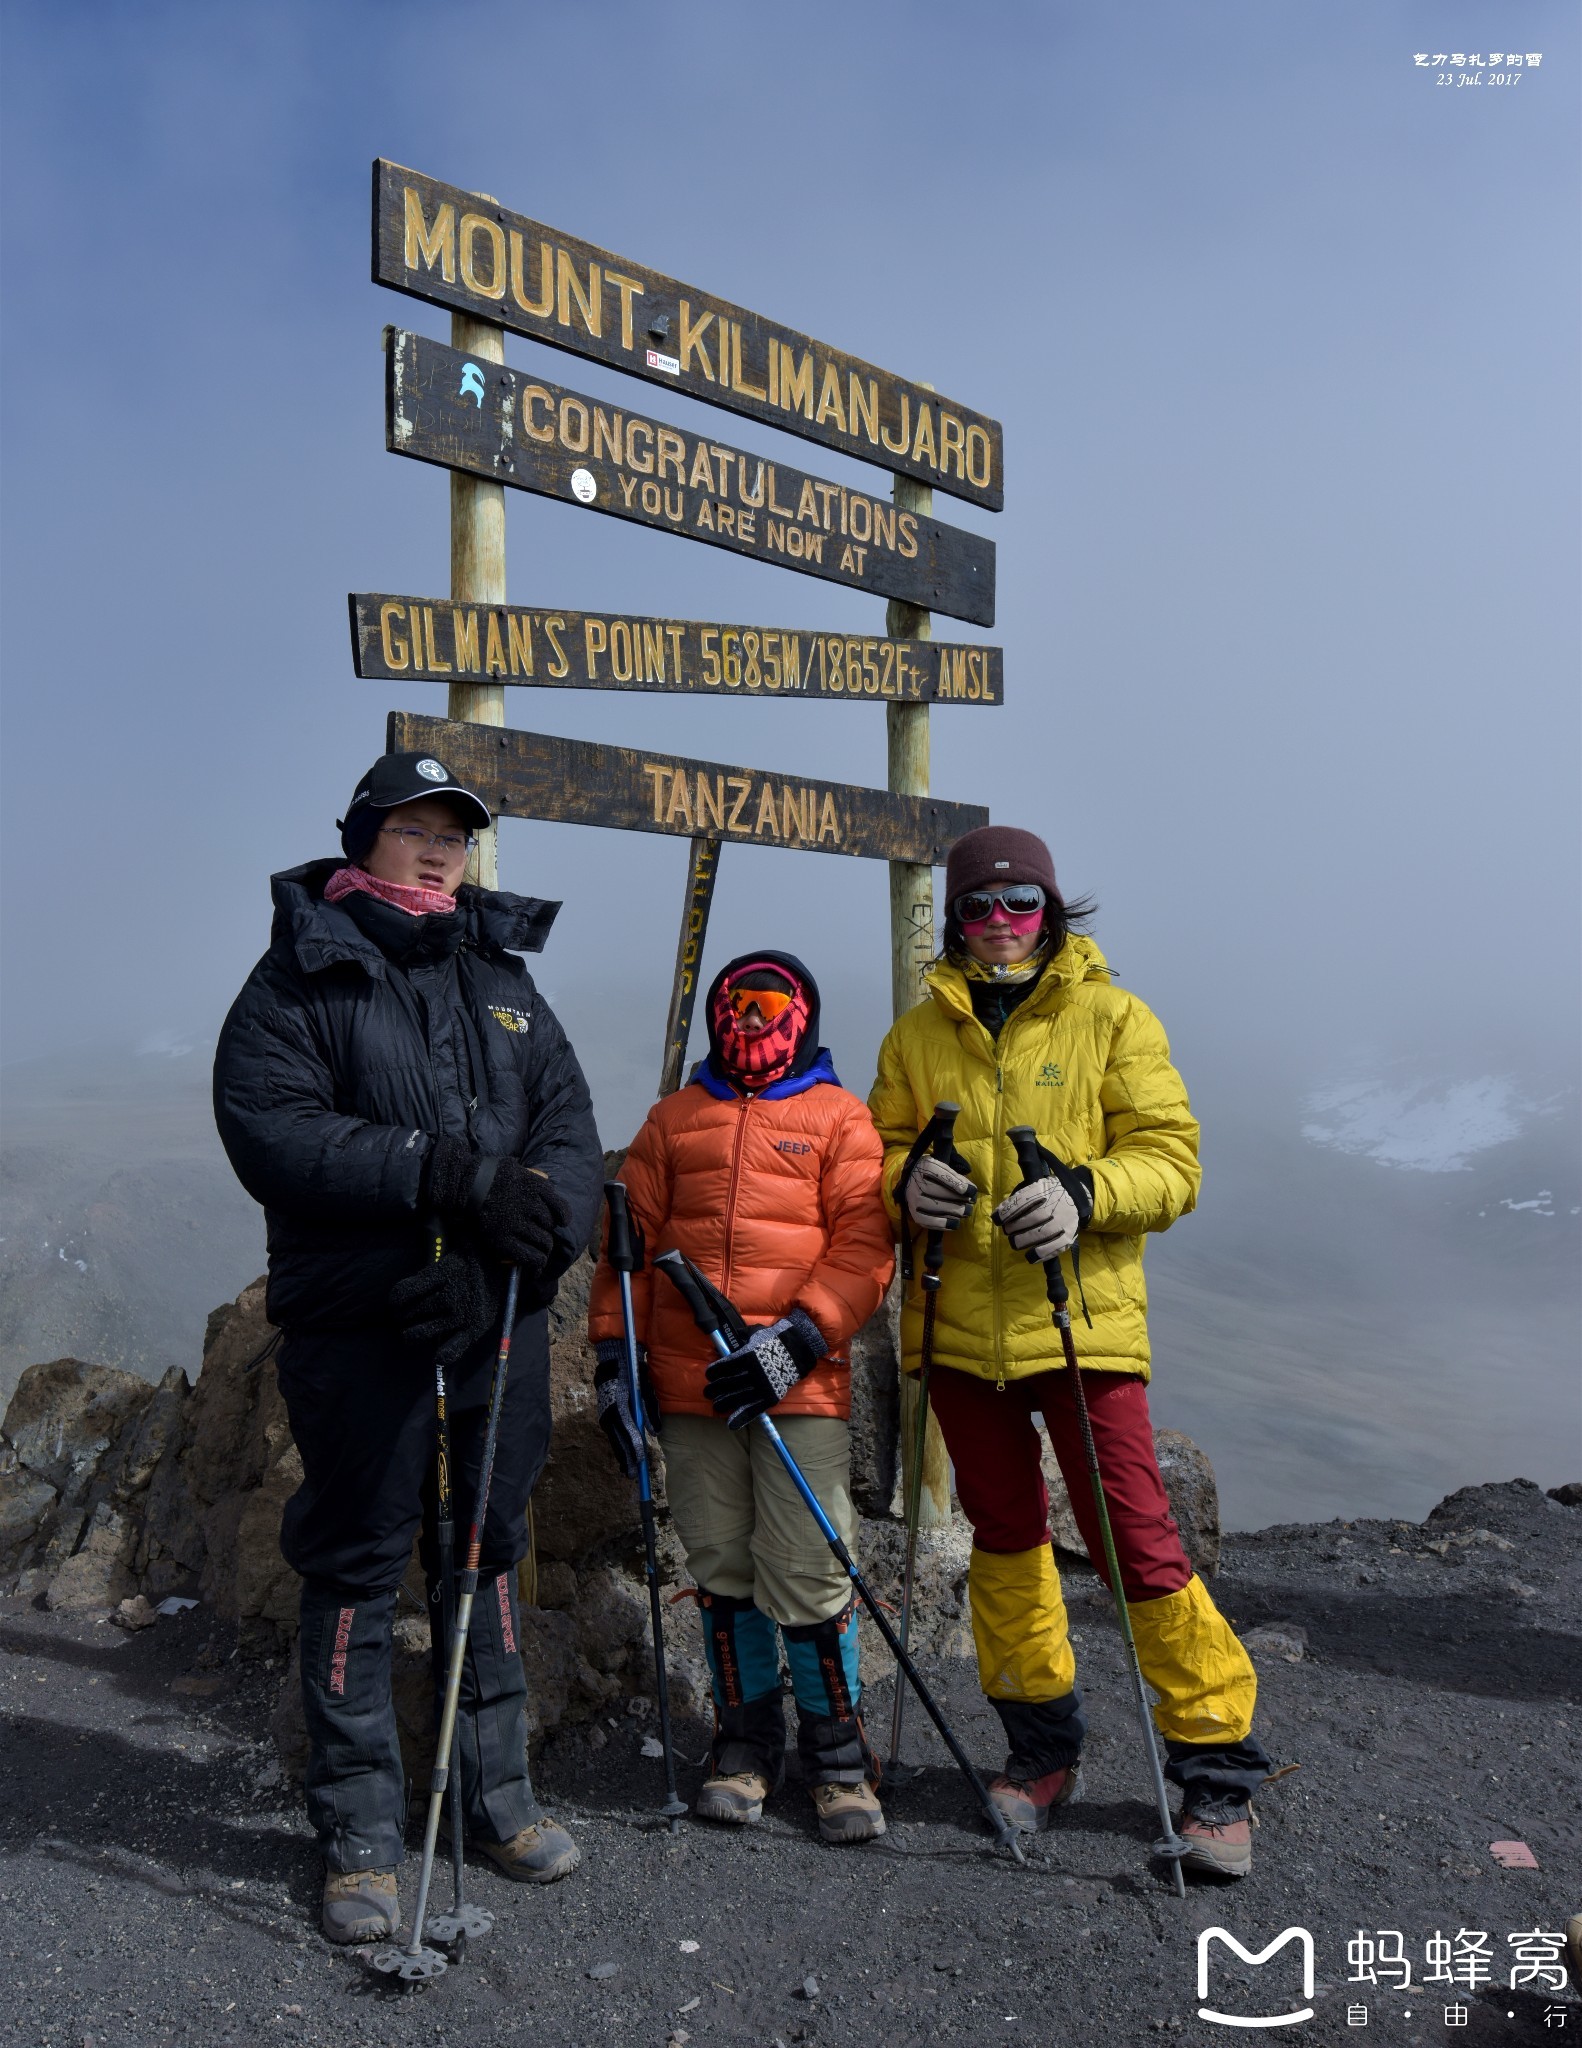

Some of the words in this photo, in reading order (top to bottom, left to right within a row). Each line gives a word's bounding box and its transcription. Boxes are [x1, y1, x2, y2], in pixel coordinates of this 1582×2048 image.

[402, 186, 645, 351] MOUNT
[678, 299, 992, 489] KILIMANJARO
[521, 384, 919, 558] CONGRATULATIONS
[617, 474, 684, 522] YOU
[696, 502, 756, 542] ARE
[766, 519, 825, 564] NOW
[840, 543, 867, 576] AT
[380, 602, 569, 678] GILMAN'S
[938, 648, 995, 700] AMSL
[643, 763, 841, 844] TANZANIA
[487, 1005, 531, 1018] MOUNTAIN
[492, 1011, 513, 1024] HARD
[774, 1141, 811, 1156] JEEP
[722, 1322, 740, 1349] SCALER
[496, 1571, 511, 1615] KOLON
[334, 1607, 356, 1651] KOLON
[501, 1614, 517, 1654] SPORT
[330, 1651, 348, 1695] SPORT
